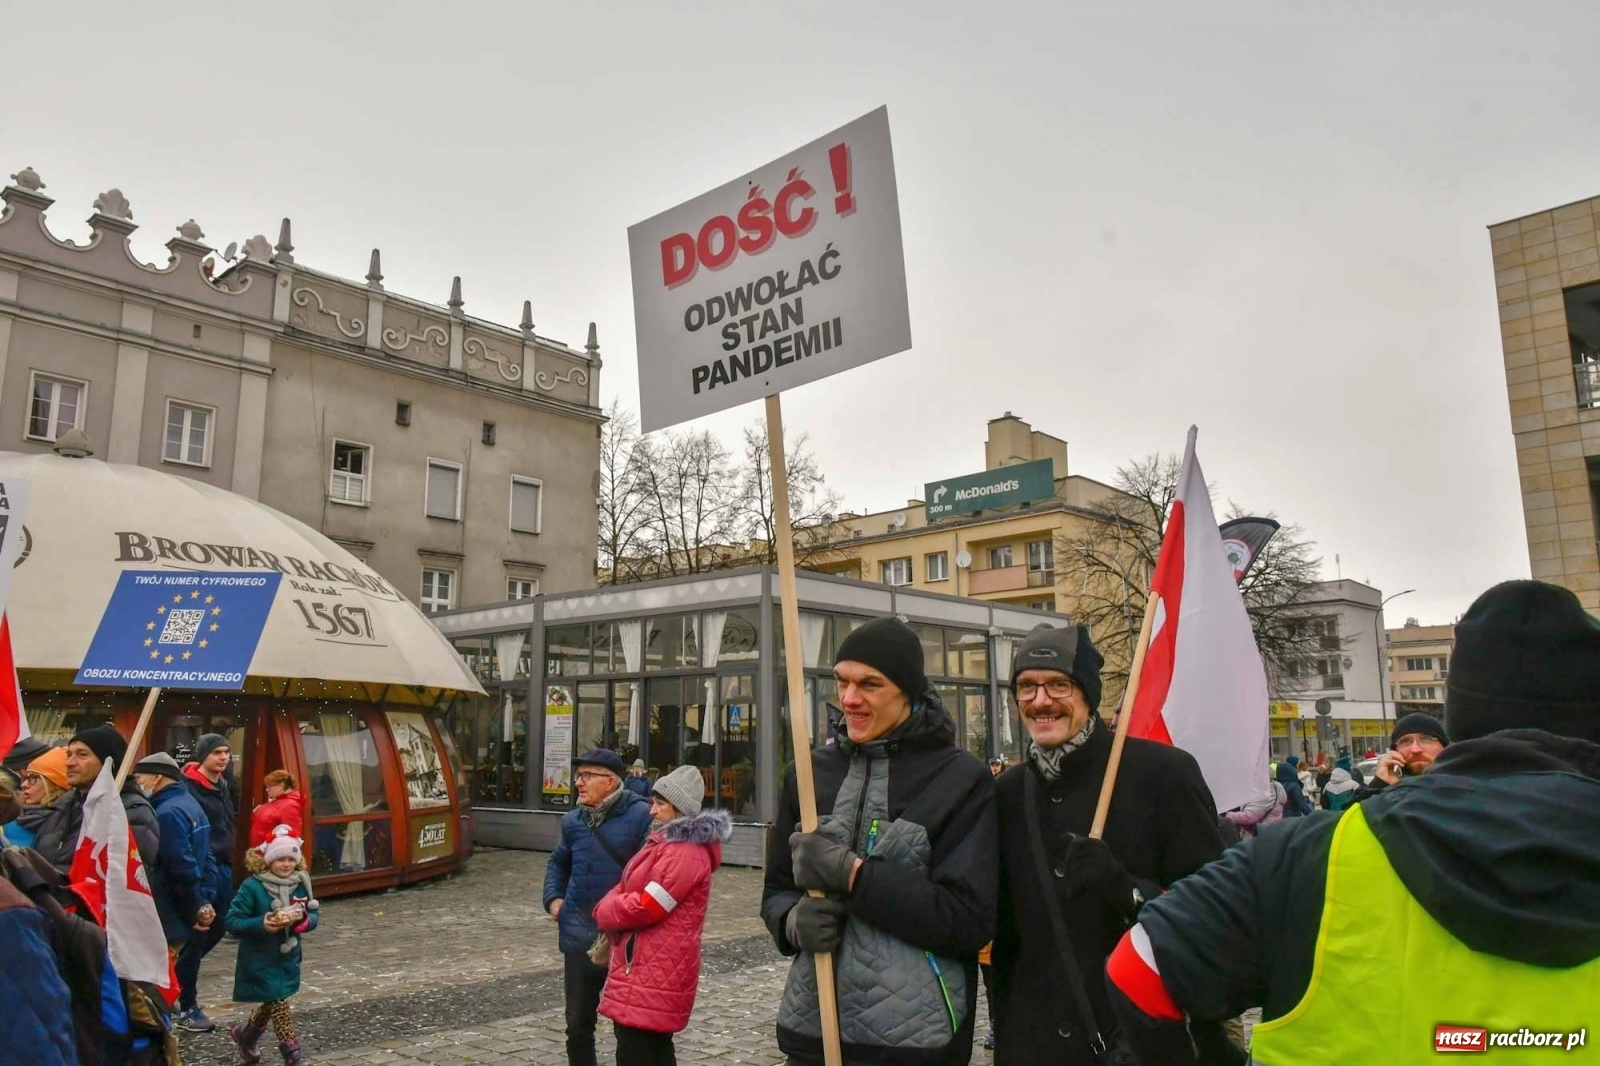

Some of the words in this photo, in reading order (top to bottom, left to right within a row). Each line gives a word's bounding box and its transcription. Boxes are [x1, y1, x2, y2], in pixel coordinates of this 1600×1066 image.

[660, 167, 818, 290] DOŚĆ
[828, 142, 857, 218] !
[684, 242, 842, 332] ODWOŁAĆ
[721, 297, 805, 351] STAN
[692, 317, 843, 394] PANDEMII
[929, 505, 944, 514] 300
[955, 479, 1020, 501] McDonald's
[114, 531, 290, 574] BROWAR
[134, 575, 160, 585] TWÓJ
[163, 576, 199, 586] NUMER
[201, 577, 267, 587] CYFROWEGO
[288, 580, 316, 593] Rok
[292, 599, 375, 640] 1567
[83, 668, 122, 679] OBOZU
[124, 669, 242, 683] KONCENTRACYJNEGO
